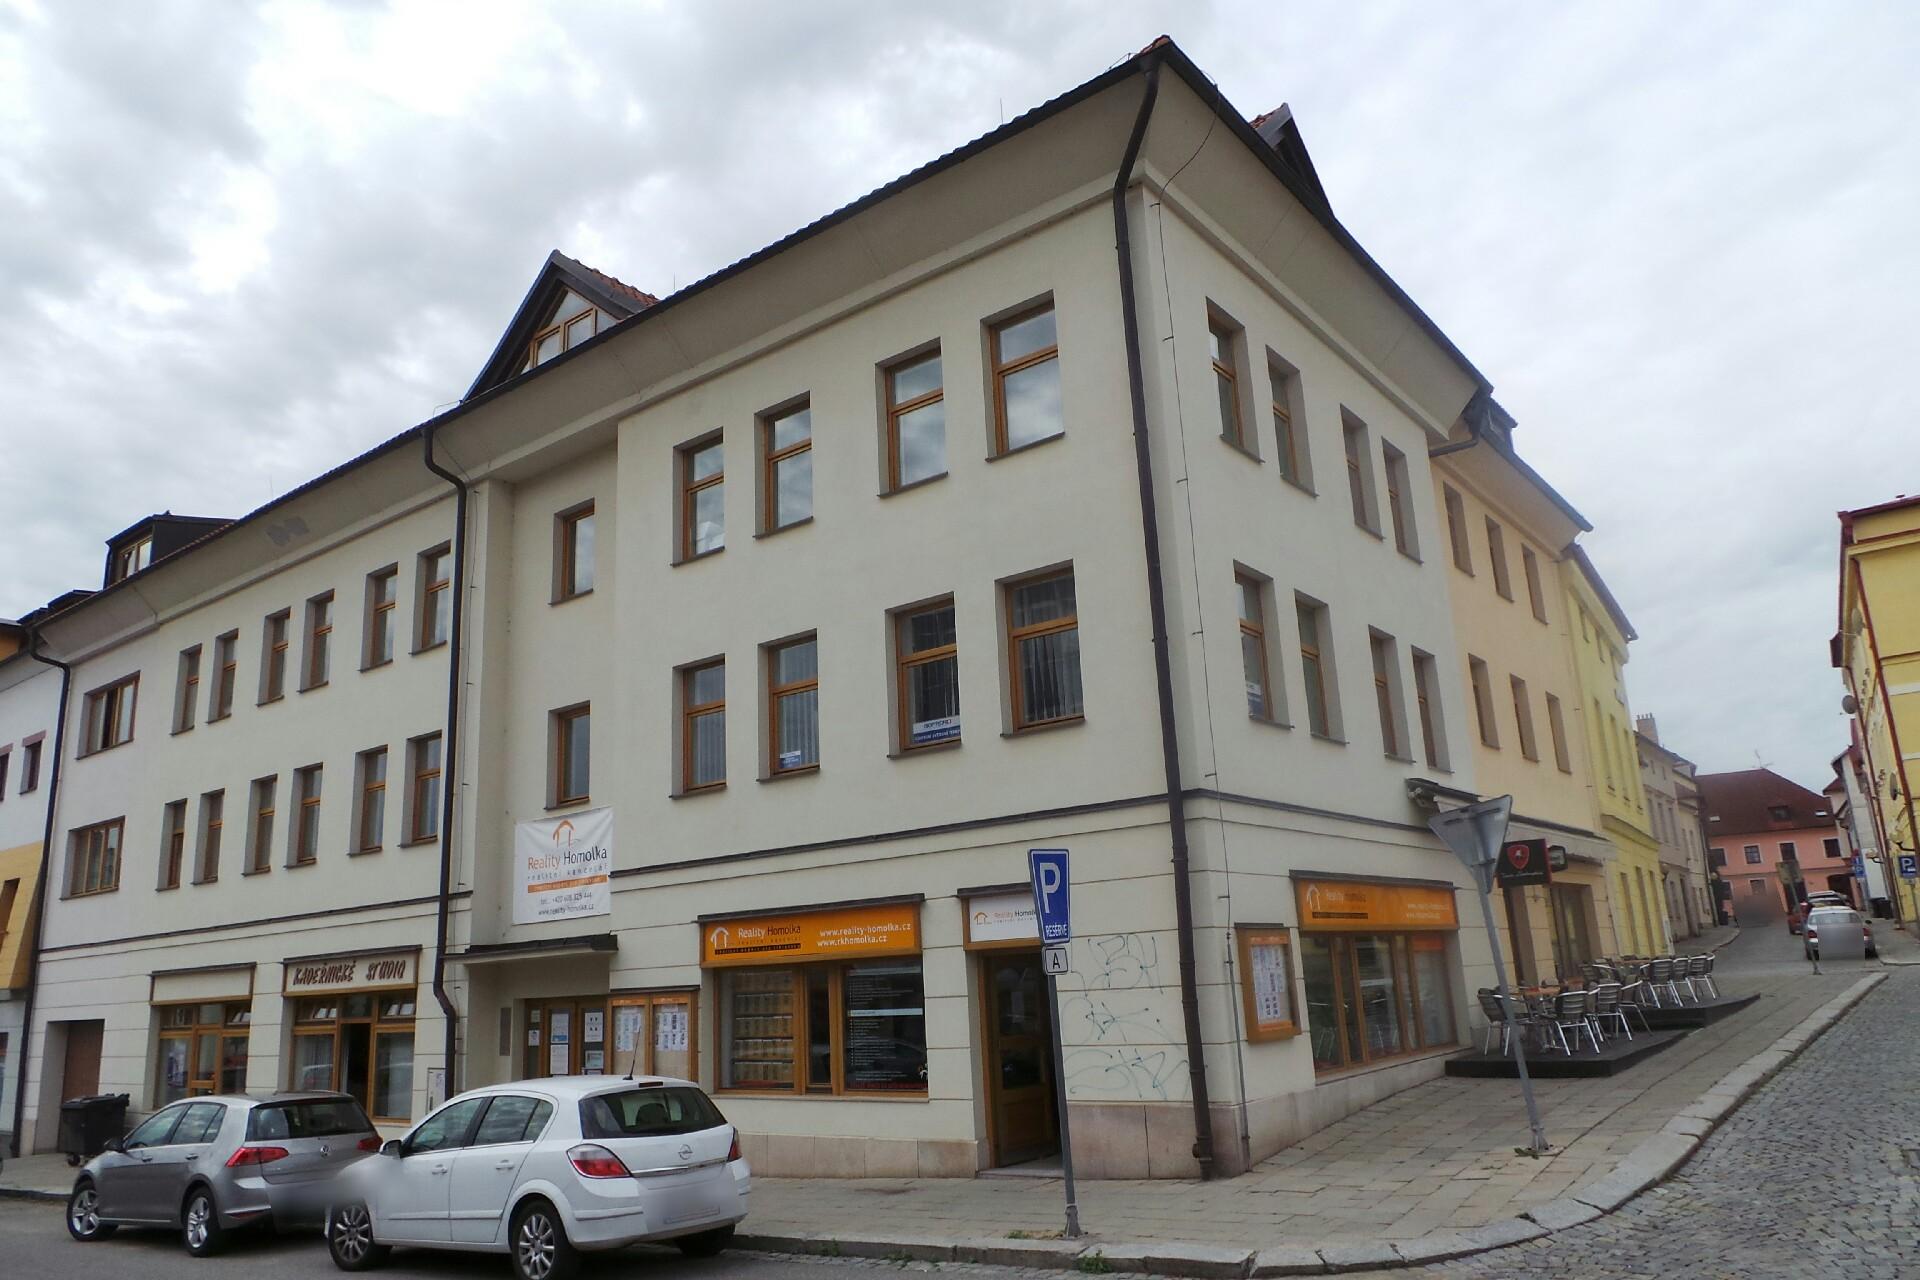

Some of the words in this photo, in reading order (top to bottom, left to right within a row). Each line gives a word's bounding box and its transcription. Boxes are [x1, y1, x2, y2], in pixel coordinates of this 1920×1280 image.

[528, 854, 560, 871] Reality
[563, 846, 607, 865] Homolka
[1040, 862, 1061, 914] P
[738, 927, 765, 939] Reality
[767, 924, 801, 936] Homolka
[819, 923, 911, 938] www.reality-homolka.cz
[816, 935, 888, 947] www.rkhomolka.cz
[1052, 952, 1061, 970] A
[366, 960, 406, 981] STUDIO
